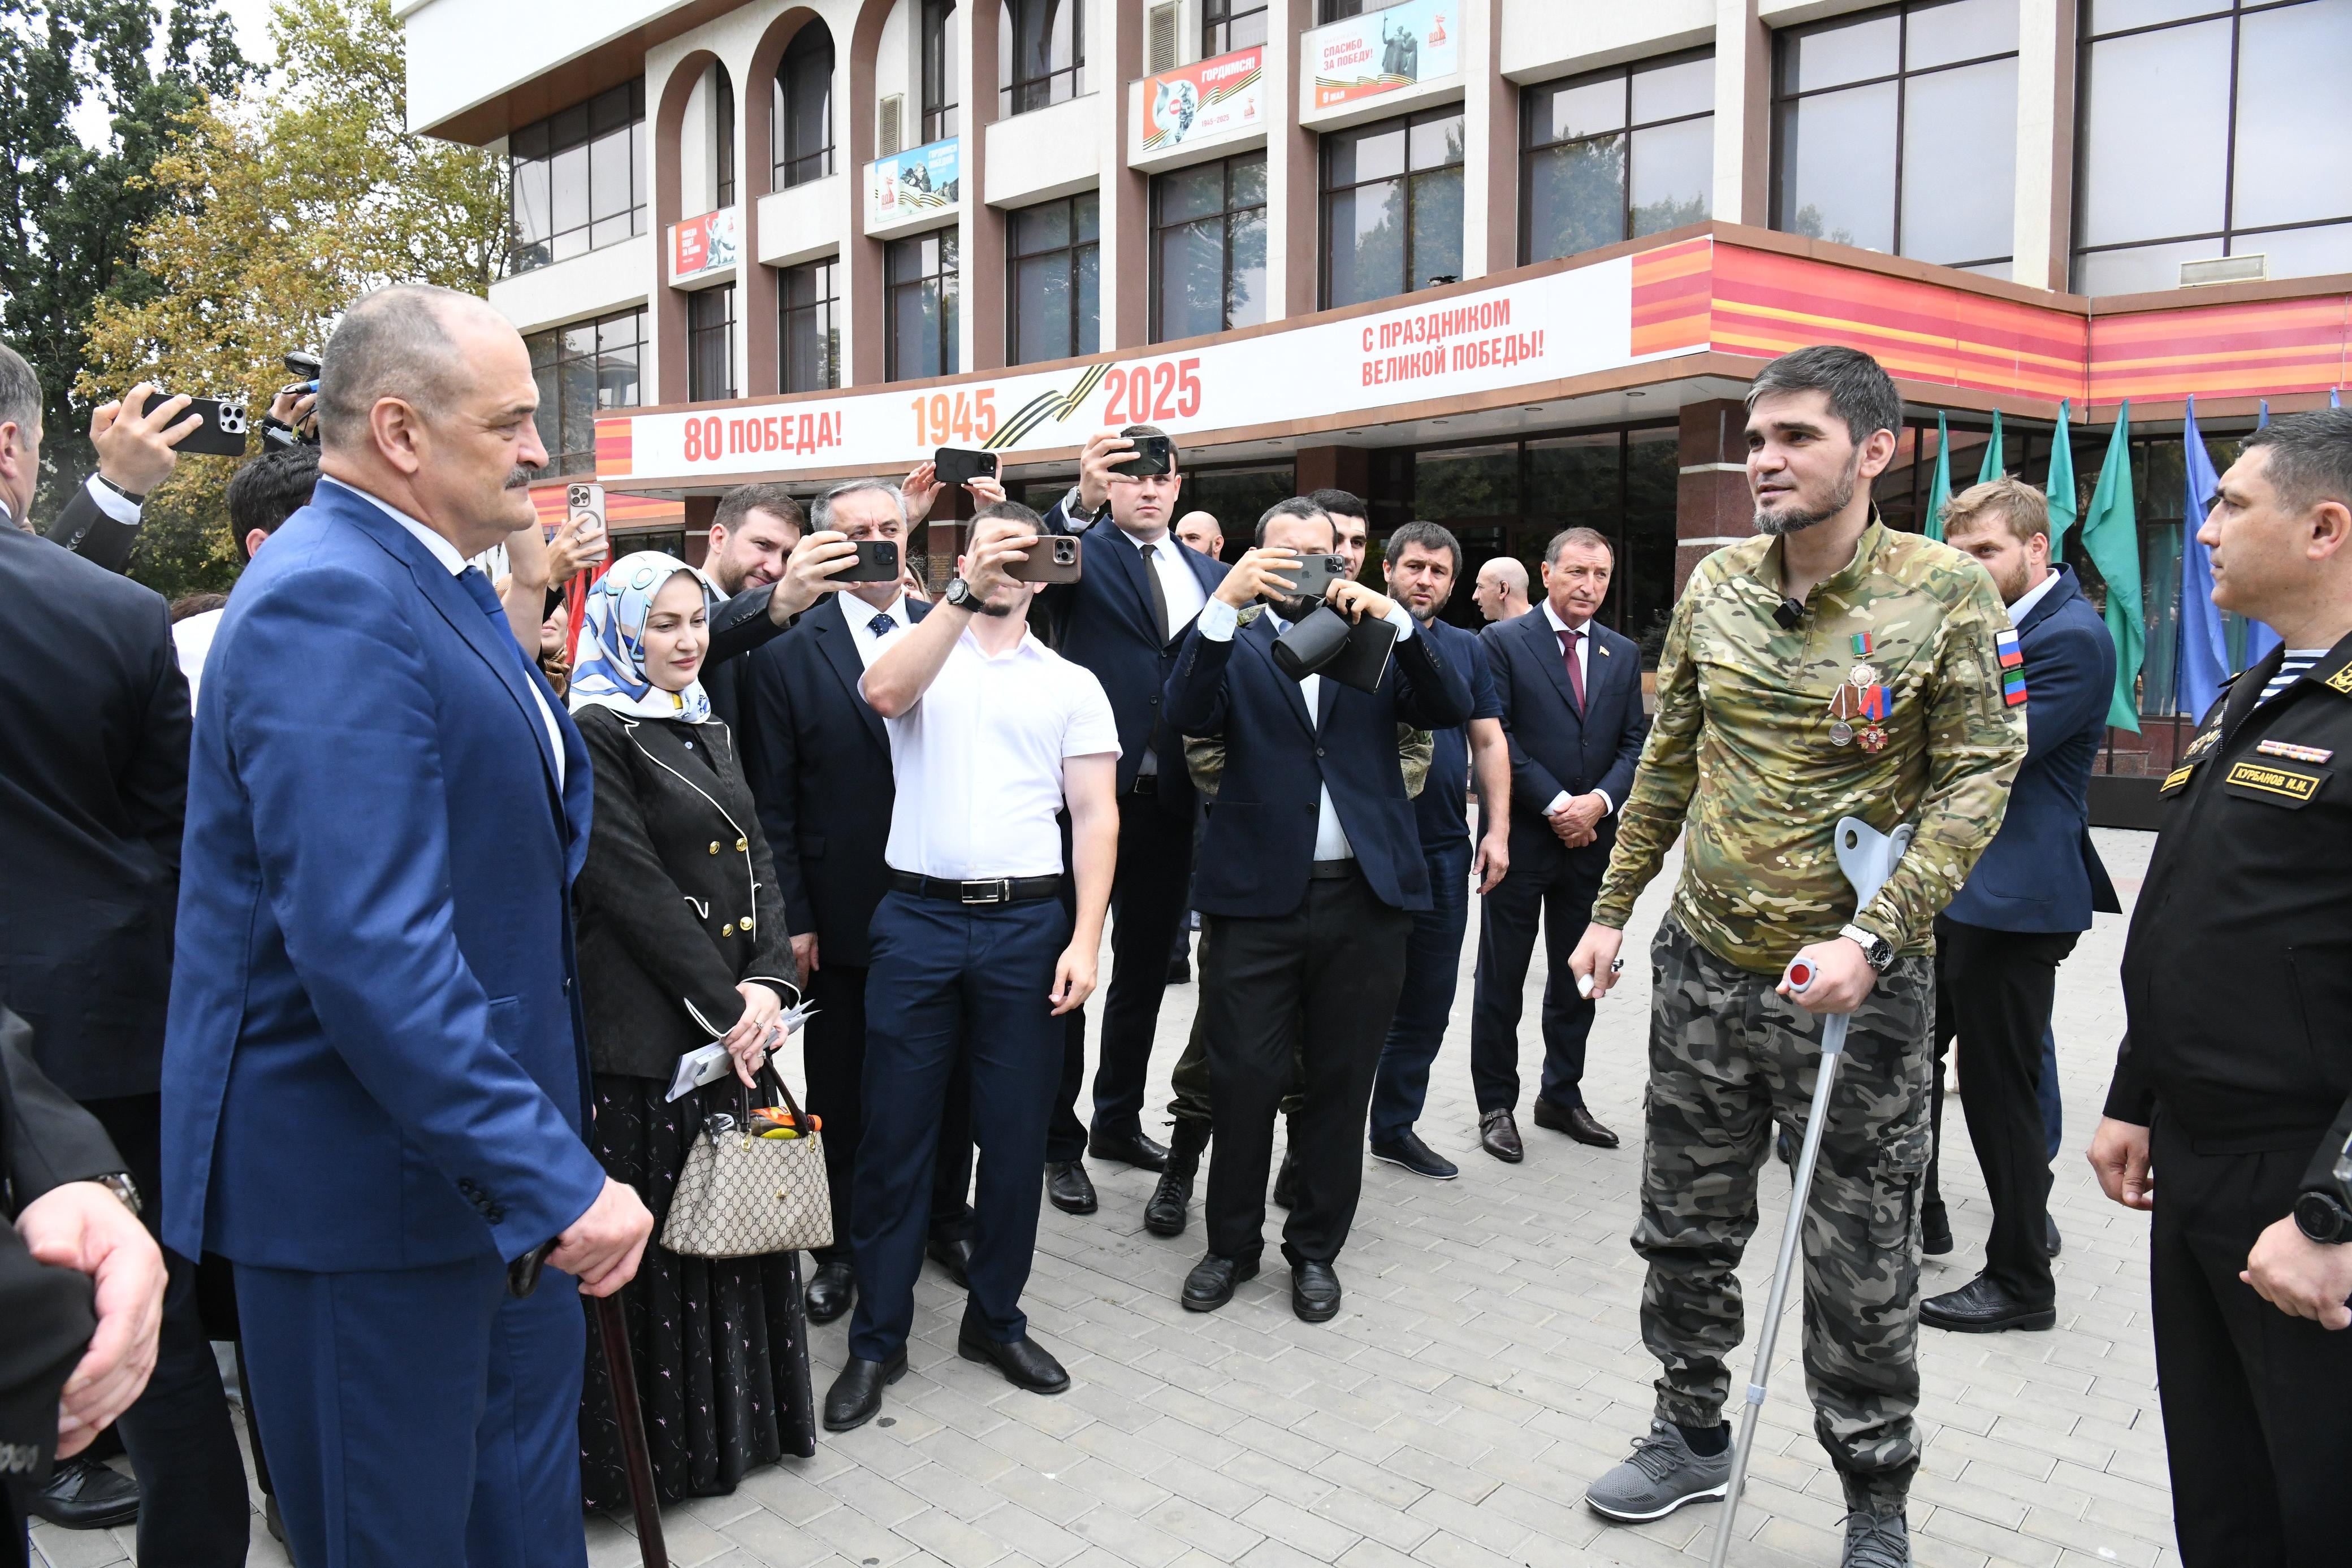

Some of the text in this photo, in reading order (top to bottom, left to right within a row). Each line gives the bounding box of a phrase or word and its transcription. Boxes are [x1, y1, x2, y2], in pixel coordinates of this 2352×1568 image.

[1324, 38, 1363, 58] СПАСИБО
[1324, 49, 1373, 71] ЗА ПОБЕДУ!
[1201, 57, 1255, 83] ГОРДИМСЯ!
[1322, 92, 1329, 103] 9
[1363, 298, 1511, 352] С ПРАЗДНИКОМ
[1362, 330, 1544, 387] ВЕЛИКОЙ ПОБЕДЫ!
[1104, 358, 1201, 426] 2025
[685, 411, 841, 461] 80 ПОБЕДА!
[911, 388, 996, 446] 1945
[2236, 768, 2307, 792] КУРБАНОВ И.И.
